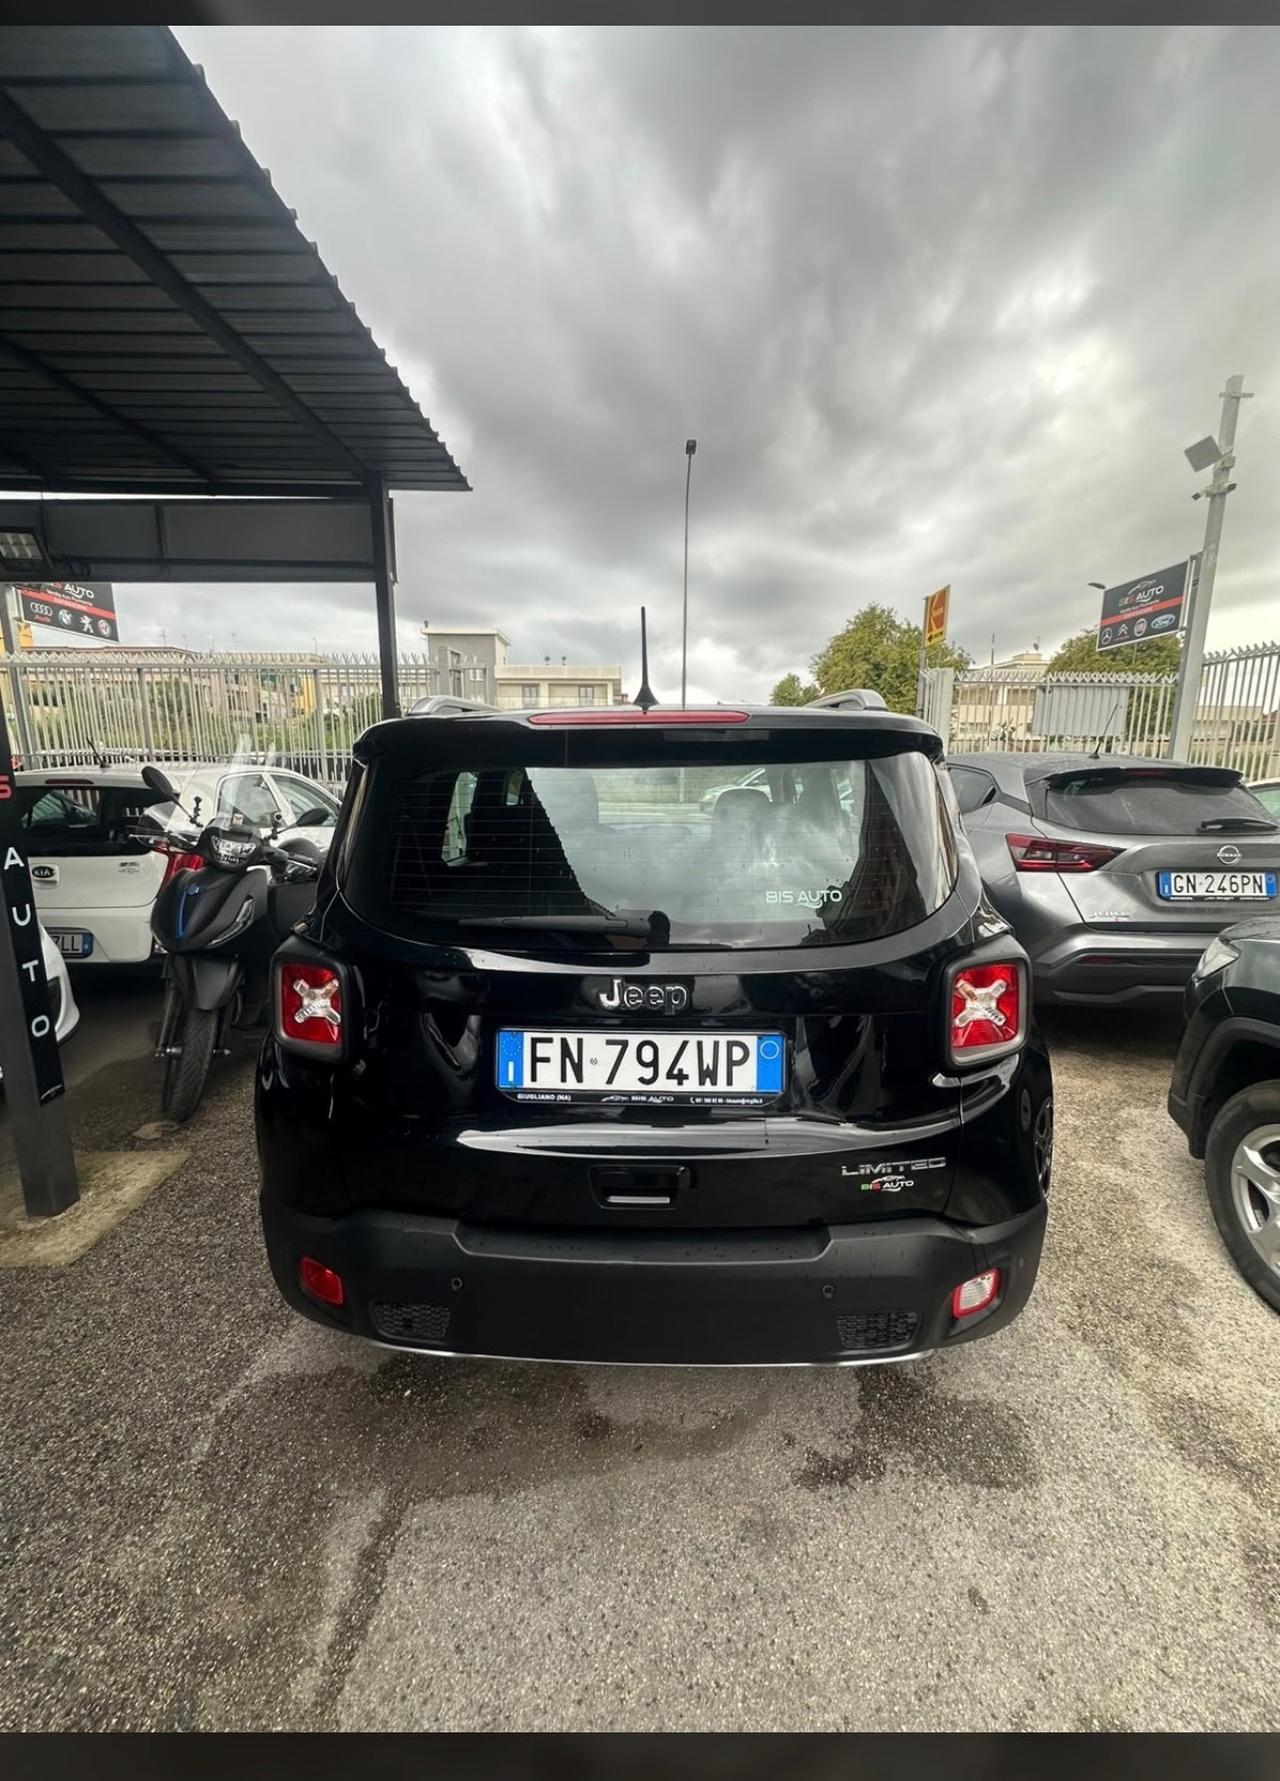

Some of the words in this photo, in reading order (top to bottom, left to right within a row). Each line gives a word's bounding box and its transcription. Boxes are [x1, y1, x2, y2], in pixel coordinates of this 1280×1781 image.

[64, 583, 94, 599] AUTO
[1136, 586, 1164, 601] AUTO
[34, 868, 50, 876] KIA
[765, 890, 794, 904] BIS
[797, 889, 842, 903] AUTO
[599, 978, 688, 1016] Jeep
[841, 1157, 947, 1176] LIMITED
[882, 1180, 914, 1190] AUTO
